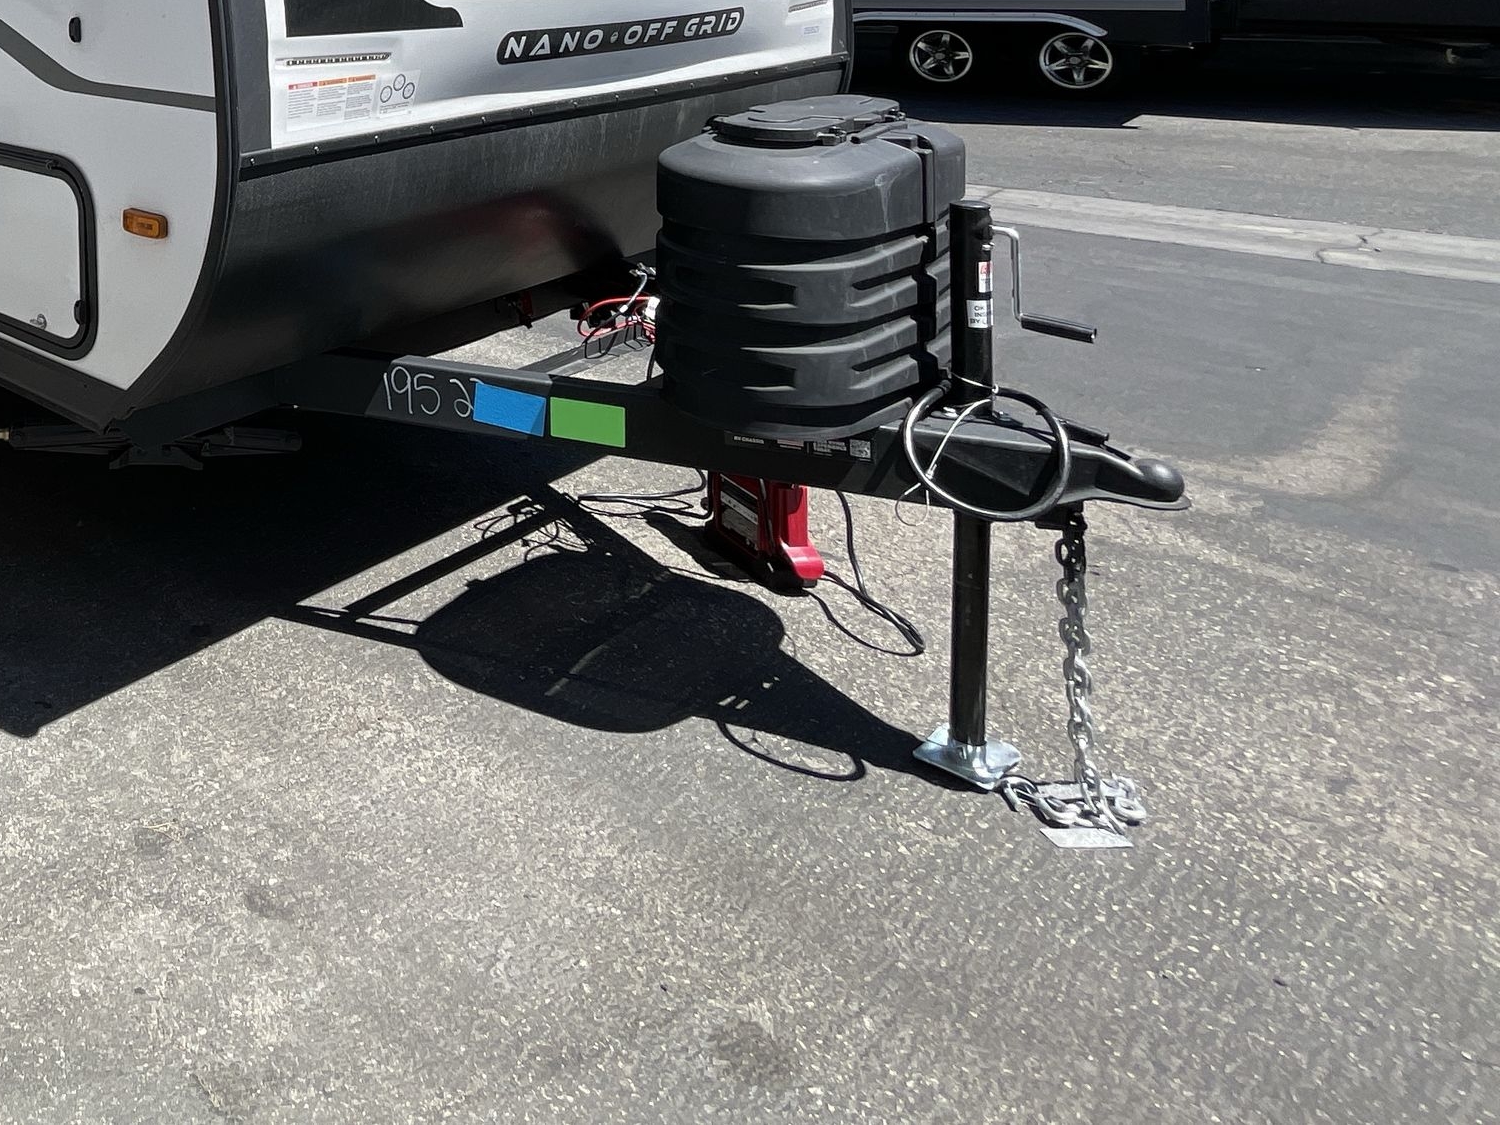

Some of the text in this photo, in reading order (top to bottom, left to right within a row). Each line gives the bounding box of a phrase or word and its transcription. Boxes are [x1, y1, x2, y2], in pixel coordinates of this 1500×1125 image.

[504, 12, 741, 59] NANO OFF GRID
